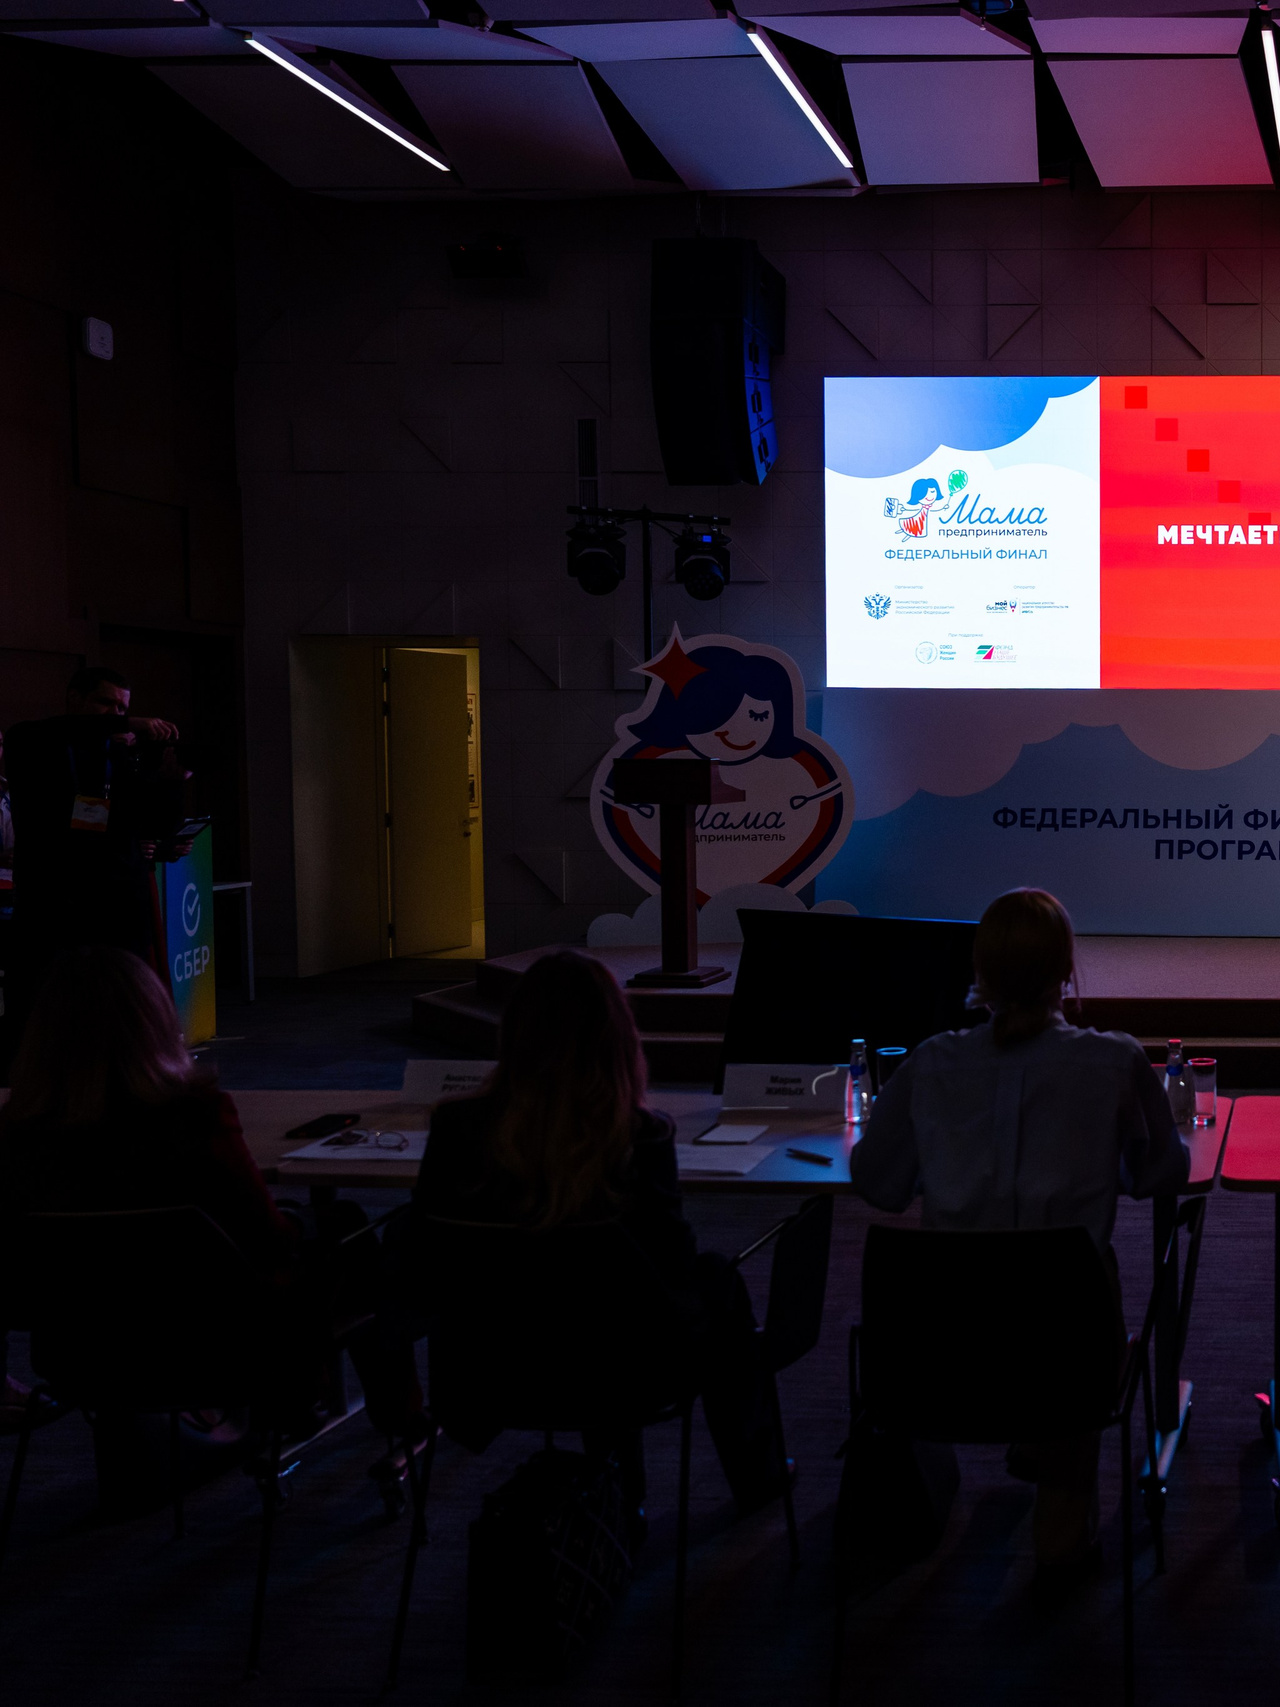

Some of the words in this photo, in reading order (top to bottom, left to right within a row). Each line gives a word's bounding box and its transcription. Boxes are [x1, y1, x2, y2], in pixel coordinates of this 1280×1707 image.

[938, 493, 1048, 525] Мама
[938, 528, 1048, 538] предприниматель
[884, 547, 992, 561] ФЕДЕРАЛЬНЫЙ
[996, 549, 1048, 560] ФИНАЛ
[993, 803, 1233, 832] ФЕДЕРАЛЬНЫЙ
[174, 945, 210, 982] СБЕР
[770, 1076, 802, 1084] Мария
[765, 1087, 805, 1096] ЖИВЫХ
